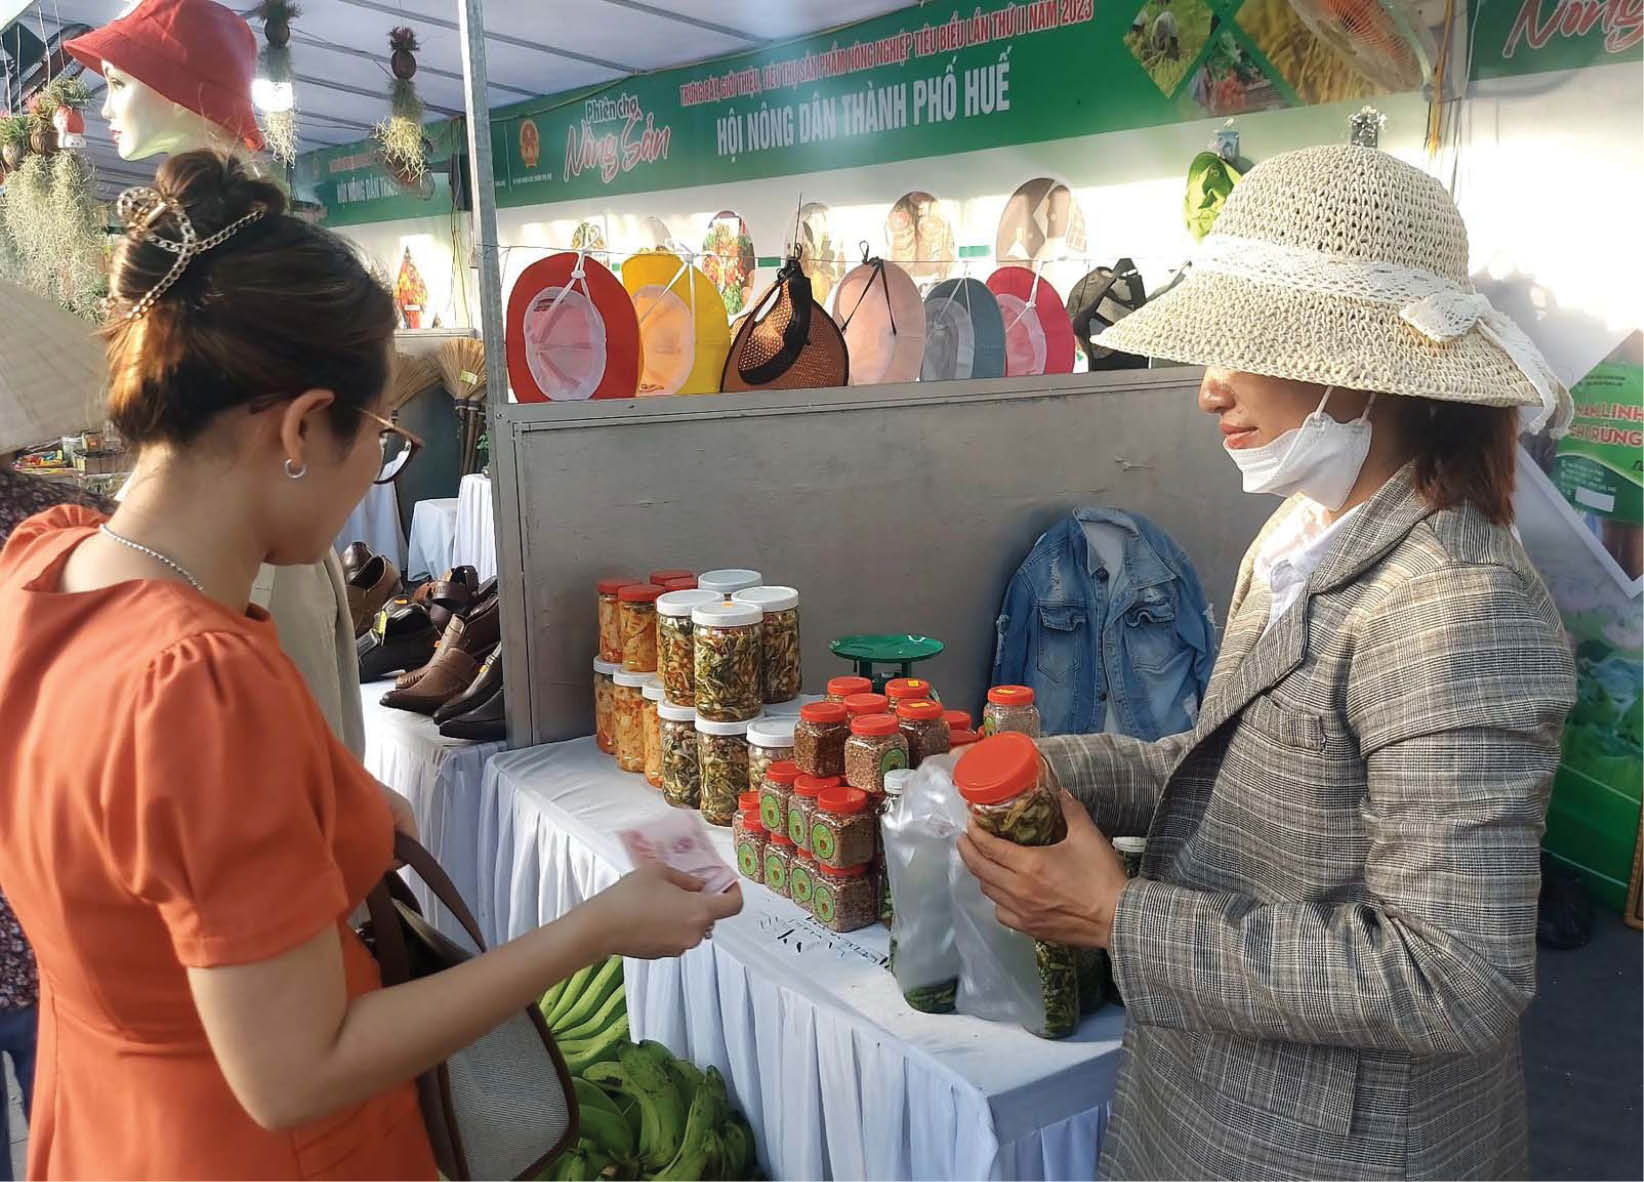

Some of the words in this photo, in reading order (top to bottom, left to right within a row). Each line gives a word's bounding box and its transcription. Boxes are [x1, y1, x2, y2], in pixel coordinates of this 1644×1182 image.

[819, 41, 847, 78] PHẨM
[847, 41, 875, 73] NÔNG
[874, 28, 912, 66] NGHIỆP
[914, 23, 938, 58] TIÊU
[938, 10, 965, 52] BIỂU
[965, 6, 990, 47] LẦN
[990, 3, 1017, 40] THỨ
[1016, 6, 1026, 35] II
[1028, 0, 1059, 33] NĂM
[1060, 0, 1094, 27] 2023
[585, 95, 617, 125] Phiên
[717, 106, 743, 162] HỘI
[747, 101, 794, 152] NÔNG
[799, 91, 838, 143] DÂN
[842, 80, 907, 136] THÀNH
[913, 56, 957, 126] PHỐ
[964, 45, 1012, 117] HUẾ
[621, 108, 671, 172] Sản
